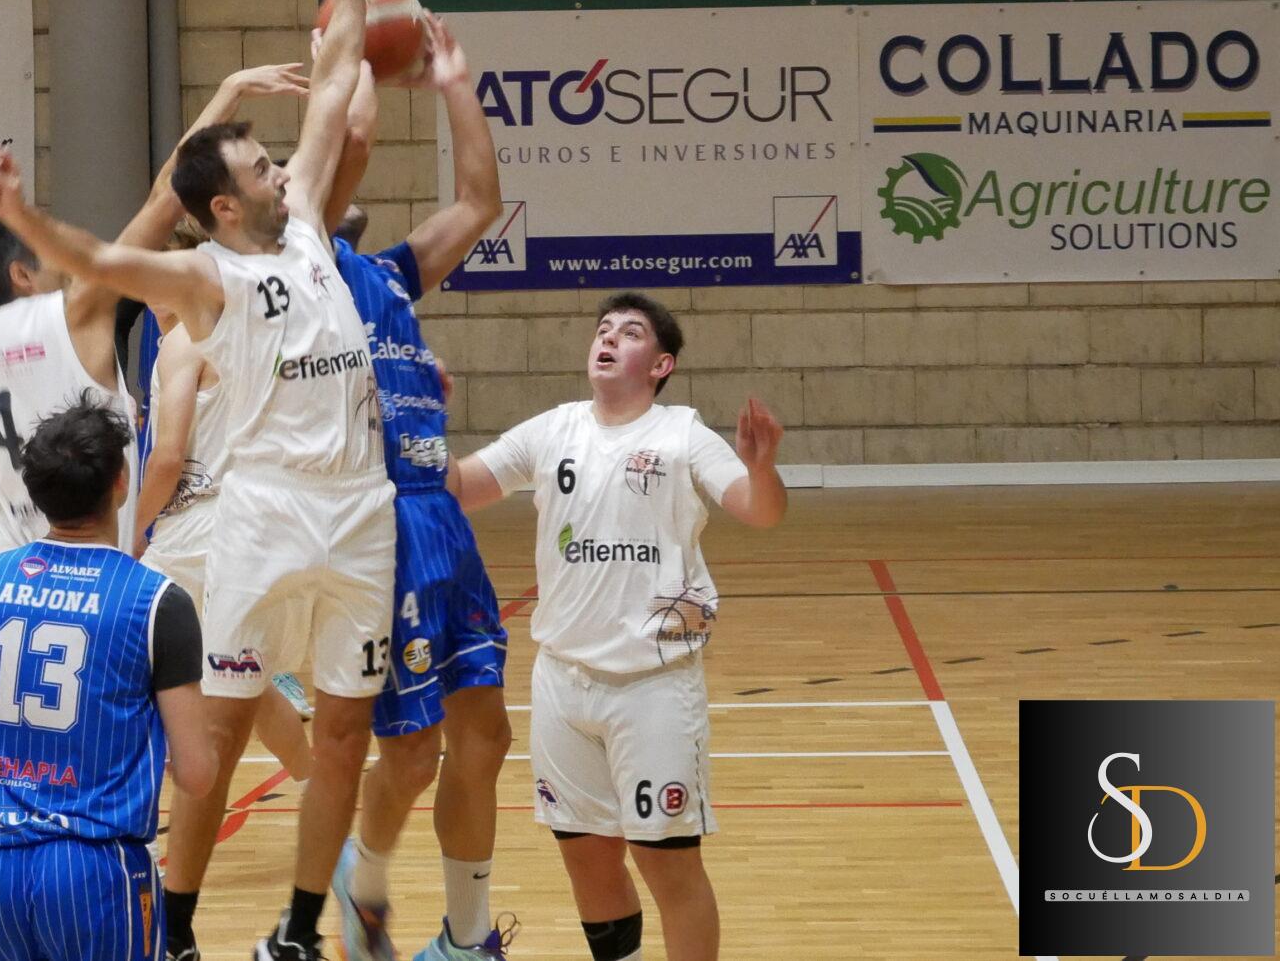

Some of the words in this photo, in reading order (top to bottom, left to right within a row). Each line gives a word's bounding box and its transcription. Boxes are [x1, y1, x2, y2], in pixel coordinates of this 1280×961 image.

[879, 30, 1260, 97] COLLADO
[968, 109, 1178, 136] MAQUINARIA
[497, 146, 591, 165] GUROS
[610, 146, 622, 163] E
[641, 142, 836, 163] INVERSIONES
[963, 168, 1271, 230] Agriculture
[775, 233, 826, 259] AXA
[1050, 222, 1238, 251] SOLUTIONS
[465, 238, 515, 265] AXA
[549, 251, 753, 275] www.atosegur.com
[257, 276, 290, 319] 13
[279, 349, 369, 380] efieman
[558, 458, 576, 495] 6
[565, 539, 661, 564] efieman
[49, 564, 101, 576] ALVAREZ
[401, 591, 420, 628] 4
[635, 779, 653, 819] 6
